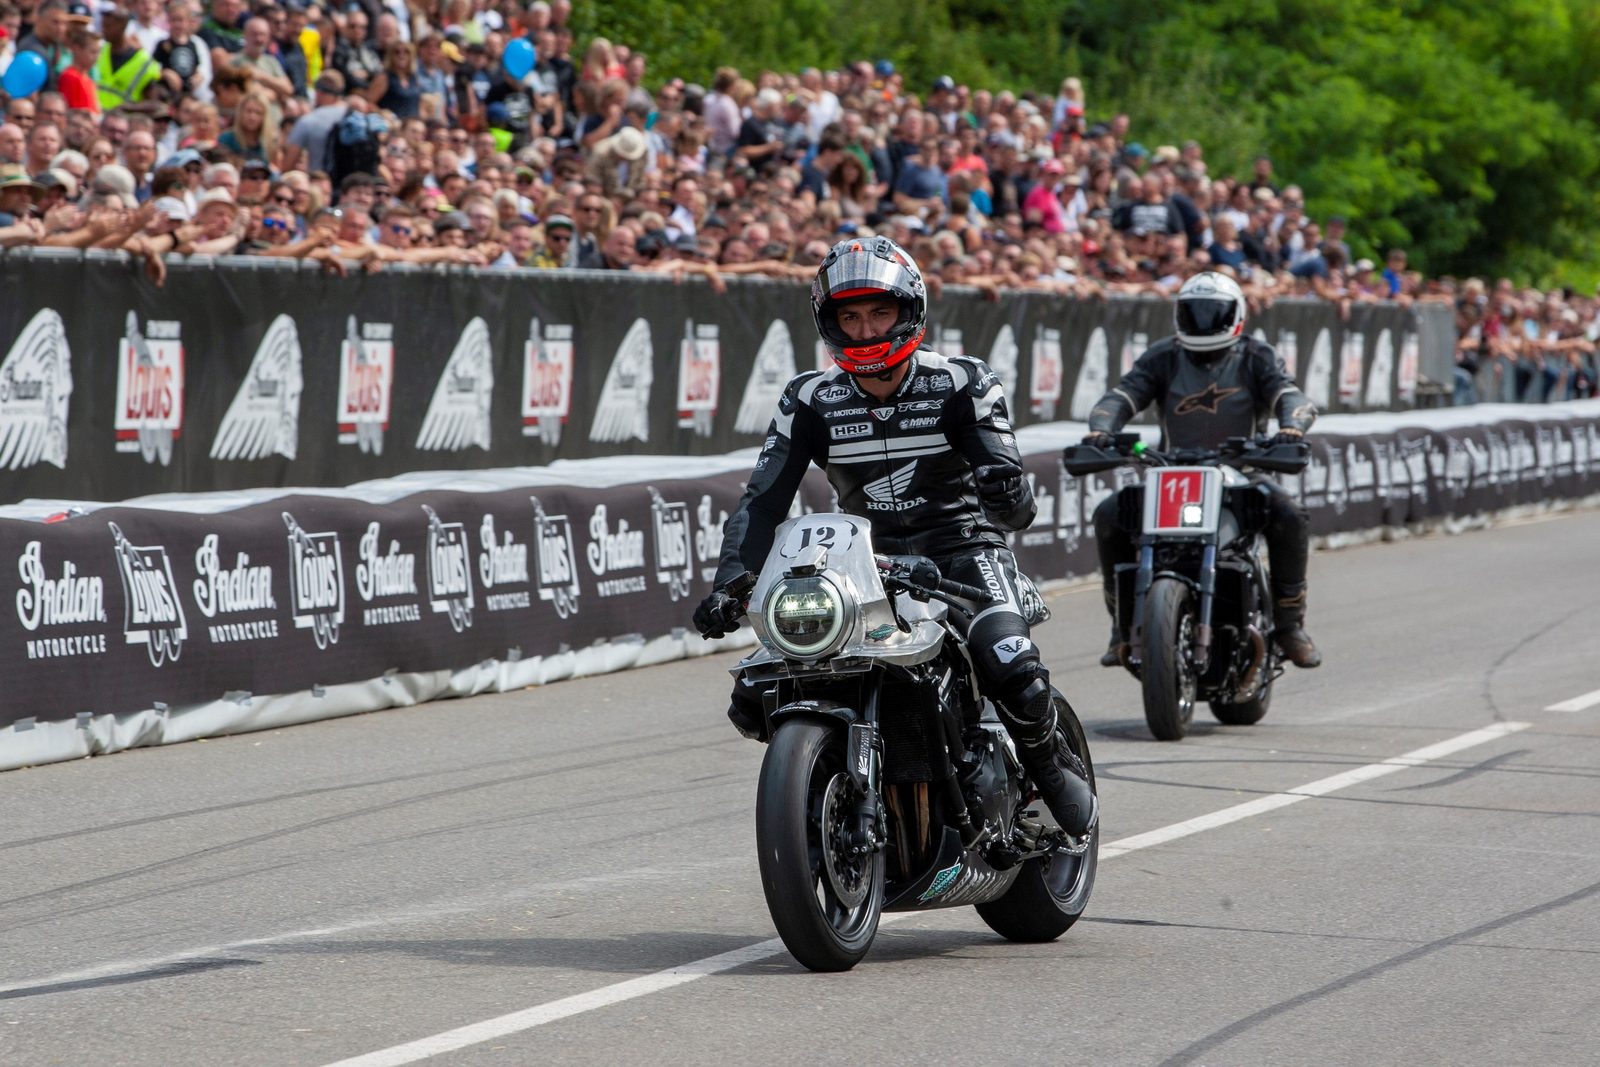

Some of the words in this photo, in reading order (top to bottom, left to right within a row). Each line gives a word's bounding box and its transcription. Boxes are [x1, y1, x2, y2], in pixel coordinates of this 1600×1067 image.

[127, 346, 173, 419] Louis
[820, 386, 850, 399] Arai
[975, 371, 998, 391] VIRC
[833, 407, 868, 417] MOTOREX
[834, 424, 869, 436] HRP
[1164, 476, 1190, 503] 11
[866, 496, 928, 511] HONDA
[798, 526, 836, 551] 12
[356, 521, 417, 601] Indian
[432, 531, 467, 595] Louis
[16, 541, 106, 631] Indian
[193, 534, 276, 617] Indian
[295, 541, 338, 610] Louis
[974, 551, 1007, 602] HONDA
[123, 555, 178, 624] Louis
[363, 604, 421, 625] MOTORCYCLE
[208, 620, 279, 643] MOTORCYCLE
[27, 634, 107, 659] MOTORCYCLE
